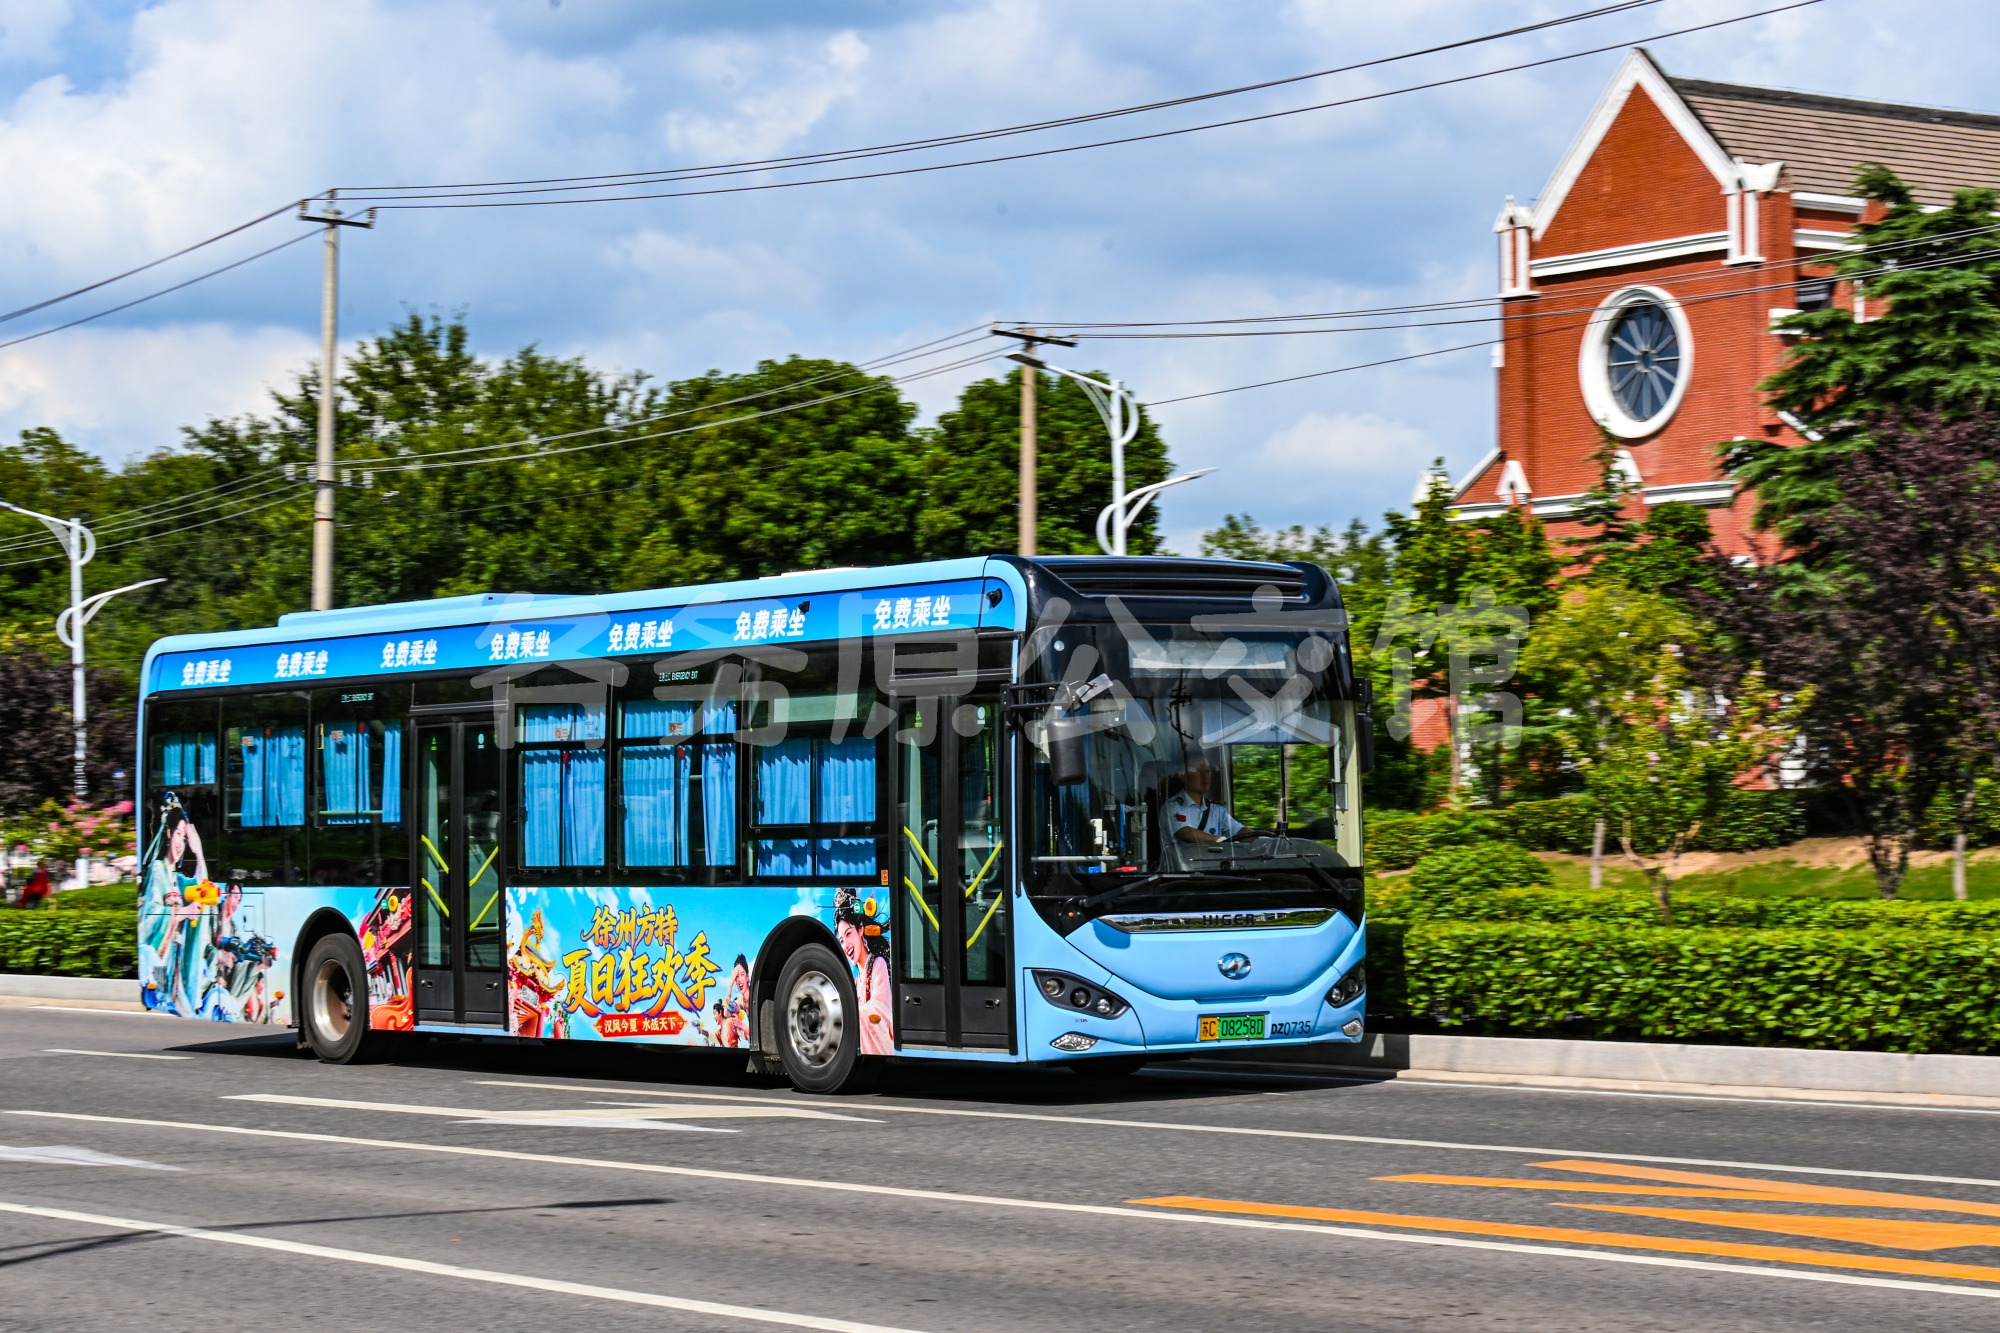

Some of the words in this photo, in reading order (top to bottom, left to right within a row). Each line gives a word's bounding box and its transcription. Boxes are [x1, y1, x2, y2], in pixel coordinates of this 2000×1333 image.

[733, 608, 805, 641] 免费乘坐
[873, 595, 951, 630] 免费乘坐
[489, 631, 551, 660] 免费乘坐
[607, 619, 673, 651] 免费乘坐
[275, 651, 329, 678] 免费乘坐
[380, 640, 437, 668] 免费乘坐
[182, 659, 232, 685] 免费乘坐
[580, 902, 679, 953] 徐州方特
[1202, 913, 1255, 926] HIGER
[562, 931, 722, 1017] 夏日狂欢季
[603, 1018, 638, 1034] 汉风今夏
[642, 1017, 677, 1032] 水战天下
[1271, 1020, 1311, 1036] DZ0735
